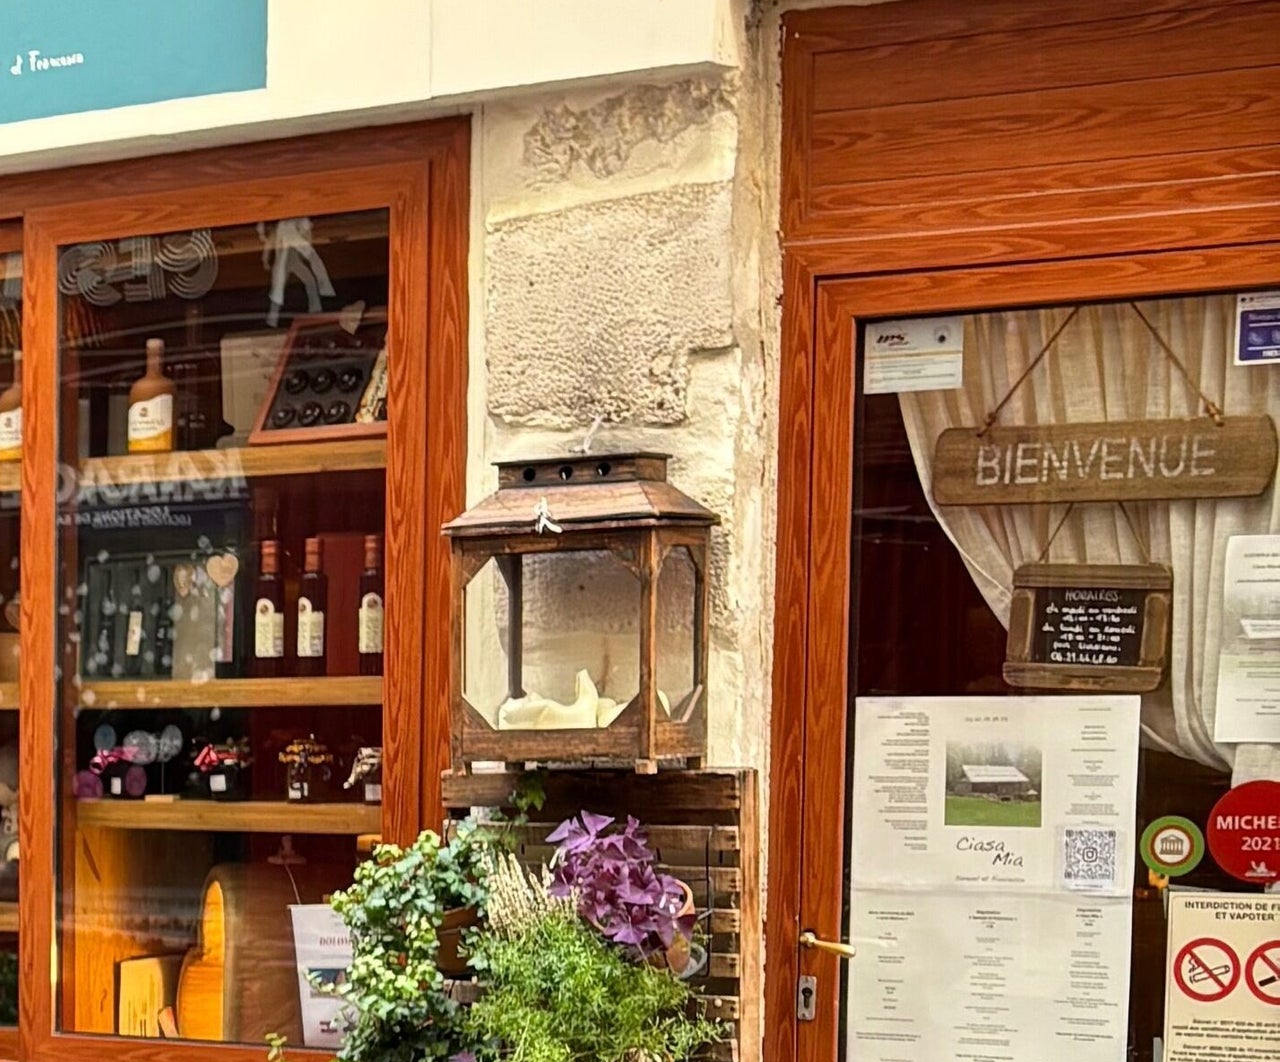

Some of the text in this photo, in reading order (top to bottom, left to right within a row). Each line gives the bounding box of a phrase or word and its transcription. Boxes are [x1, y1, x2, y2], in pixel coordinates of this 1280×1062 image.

[976, 435, 1216, 486] BIENVENUE
[956, 837, 1005, 851] Ciasa
[992, 853, 1024, 868] Mia
[1185, 901, 1252, 910] INTERDICTION
[1255, 903, 1268, 911] DE
[1215, 912, 1275, 921] ET VAPOTER
